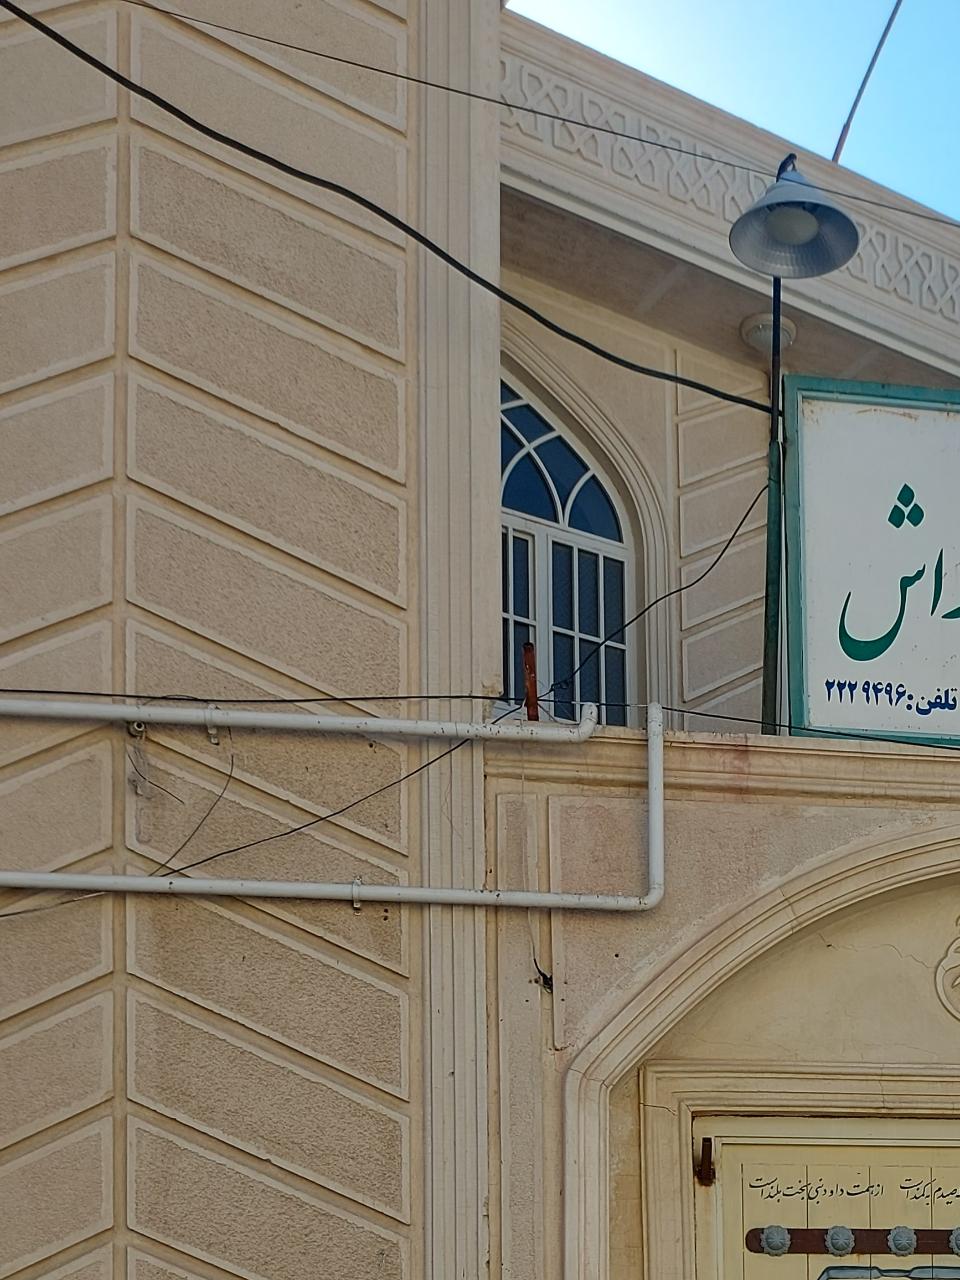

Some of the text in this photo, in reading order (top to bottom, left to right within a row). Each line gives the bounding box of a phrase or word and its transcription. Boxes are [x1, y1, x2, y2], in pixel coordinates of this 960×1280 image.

[782, 1179, 812, 1201] بخت
[807, 1177, 824, 1205] نبی
[846, 1183, 875, 1197] همت
[874, 1183, 884, 1197] از
